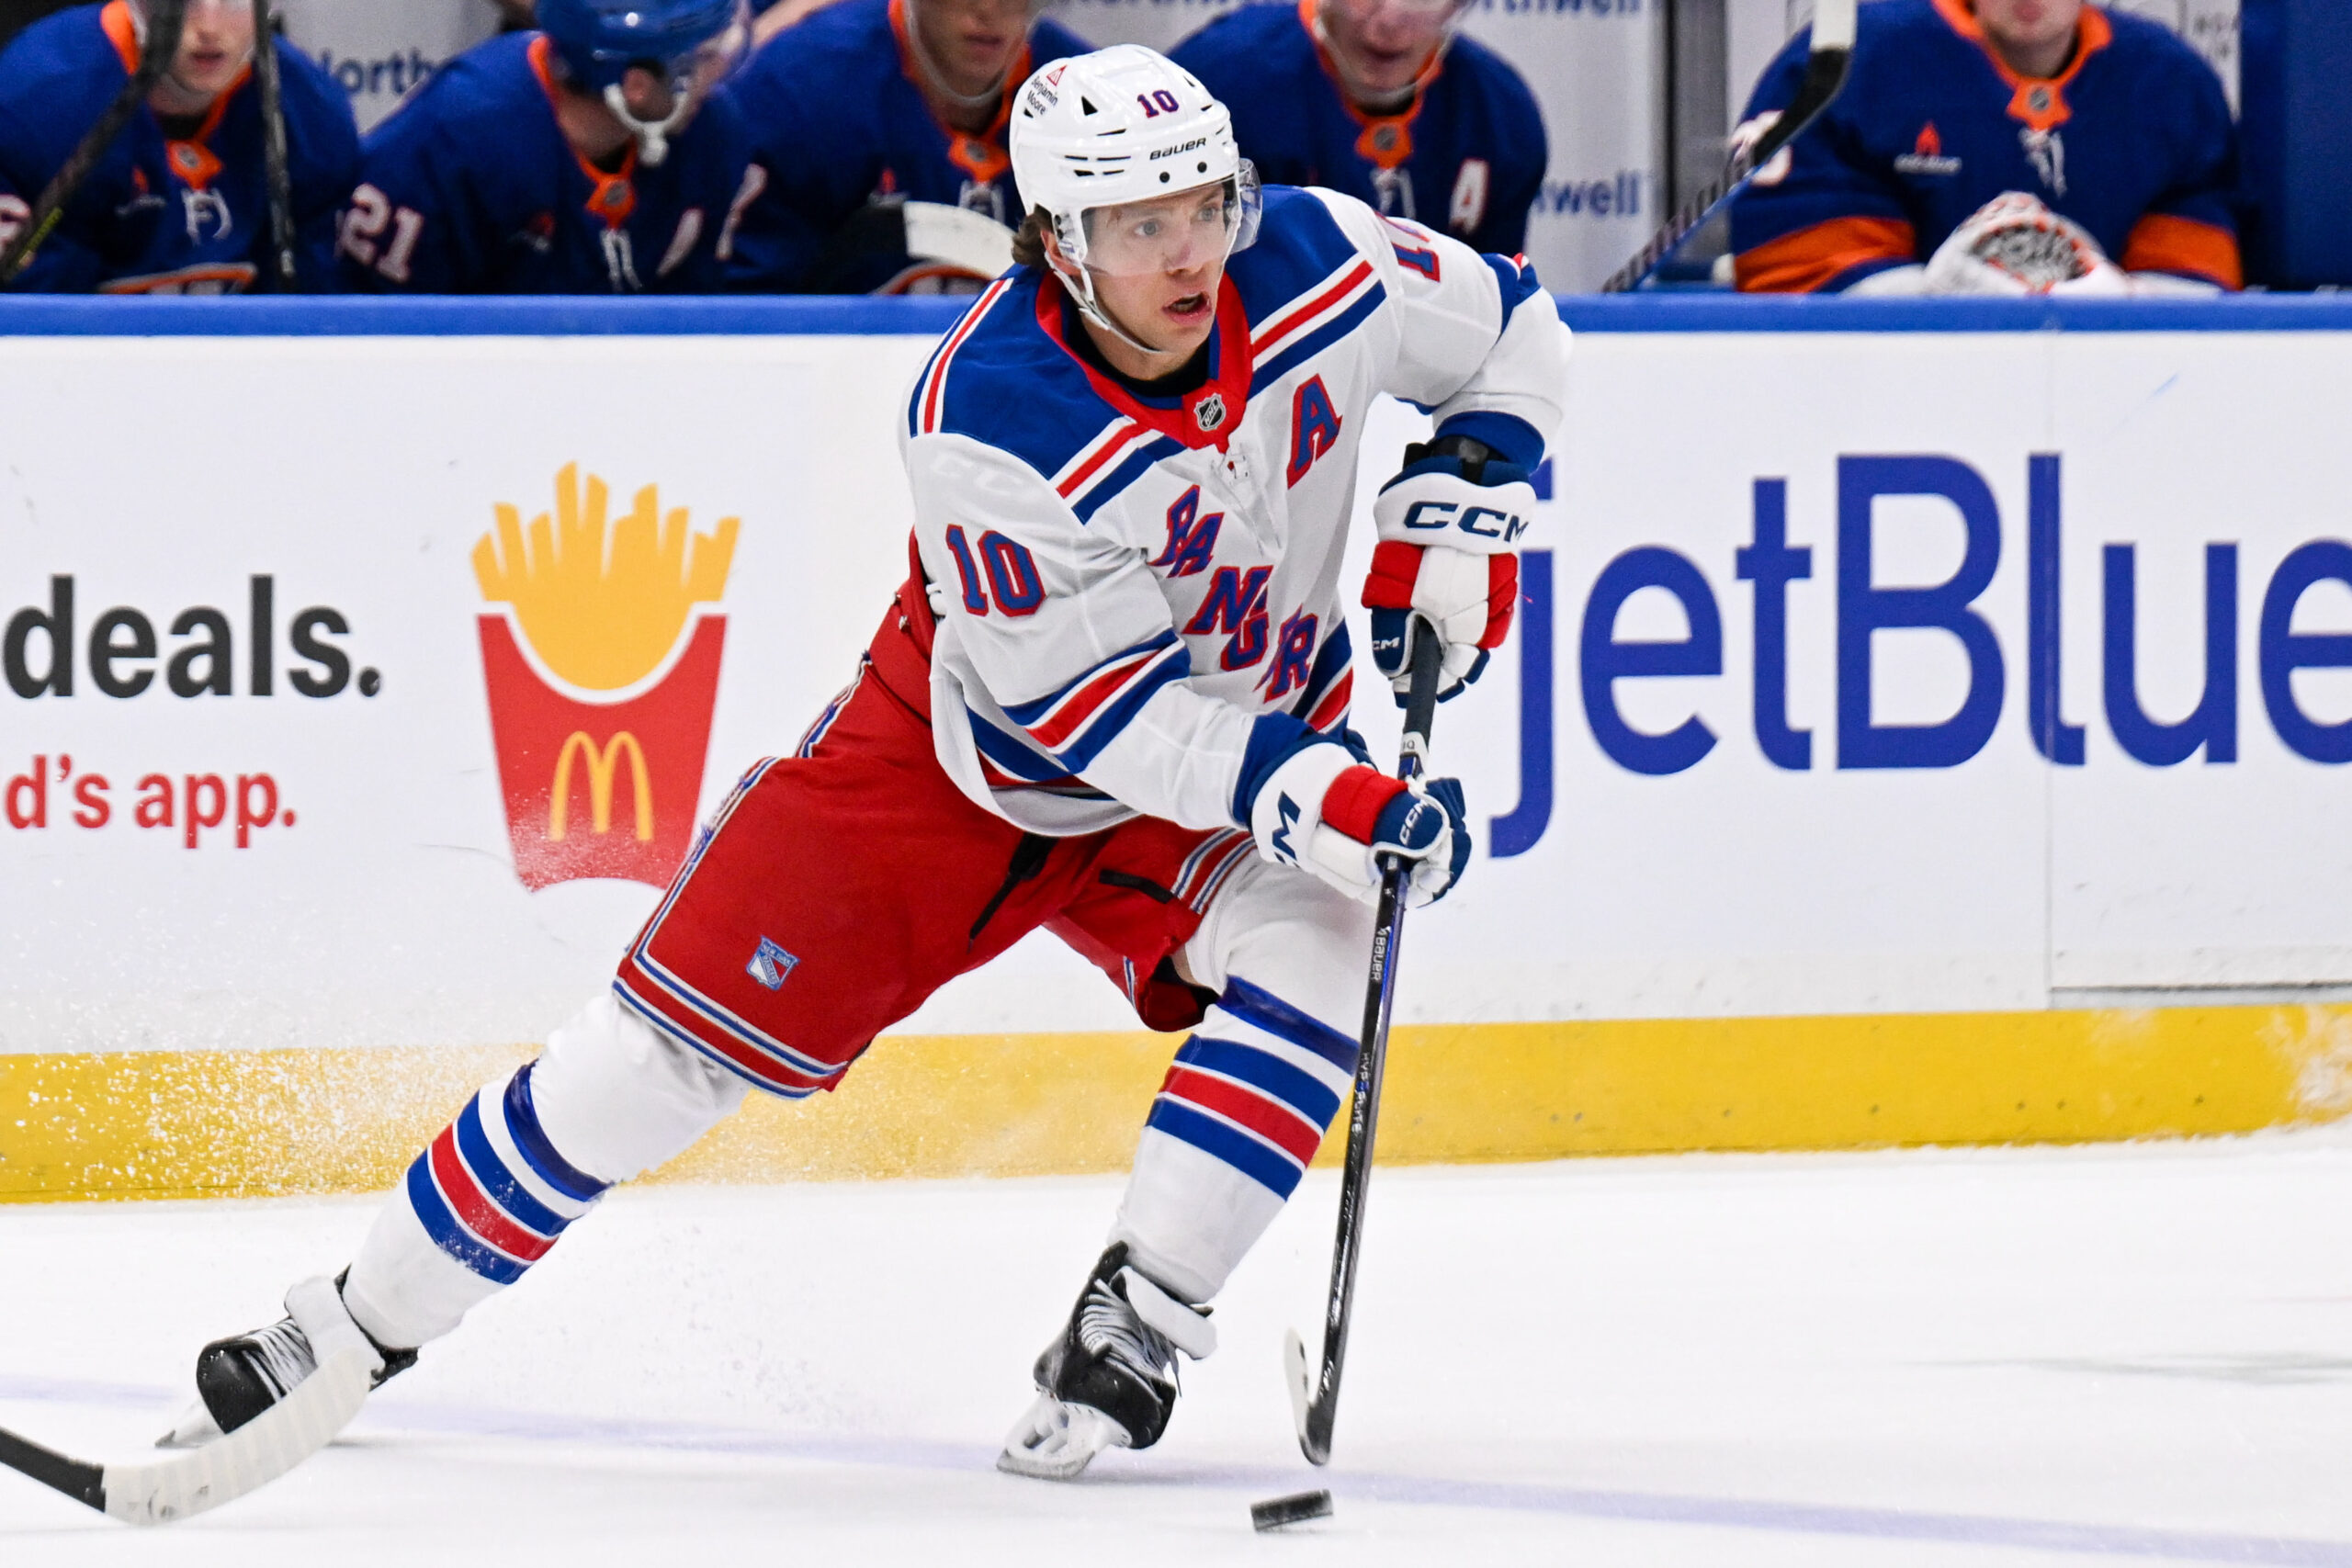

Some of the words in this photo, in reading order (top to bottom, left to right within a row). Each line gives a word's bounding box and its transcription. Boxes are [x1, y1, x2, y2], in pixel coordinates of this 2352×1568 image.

[1026, 89, 1046, 116] Moore
[1031, 74, 1058, 107] Benjamin
[1136, 89, 1180, 118] 10
[1148, 137, 1207, 161] BAUER
[340, 182, 424, 283] 21
[1285, 372, 1343, 490] A
[1403, 501, 1530, 543] CCM
[944, 523, 1047, 618] 10
[2, 573, 383, 700] deals.
[1488, 454, 2352, 858] jetBlue
[133, 770, 298, 850] app.
